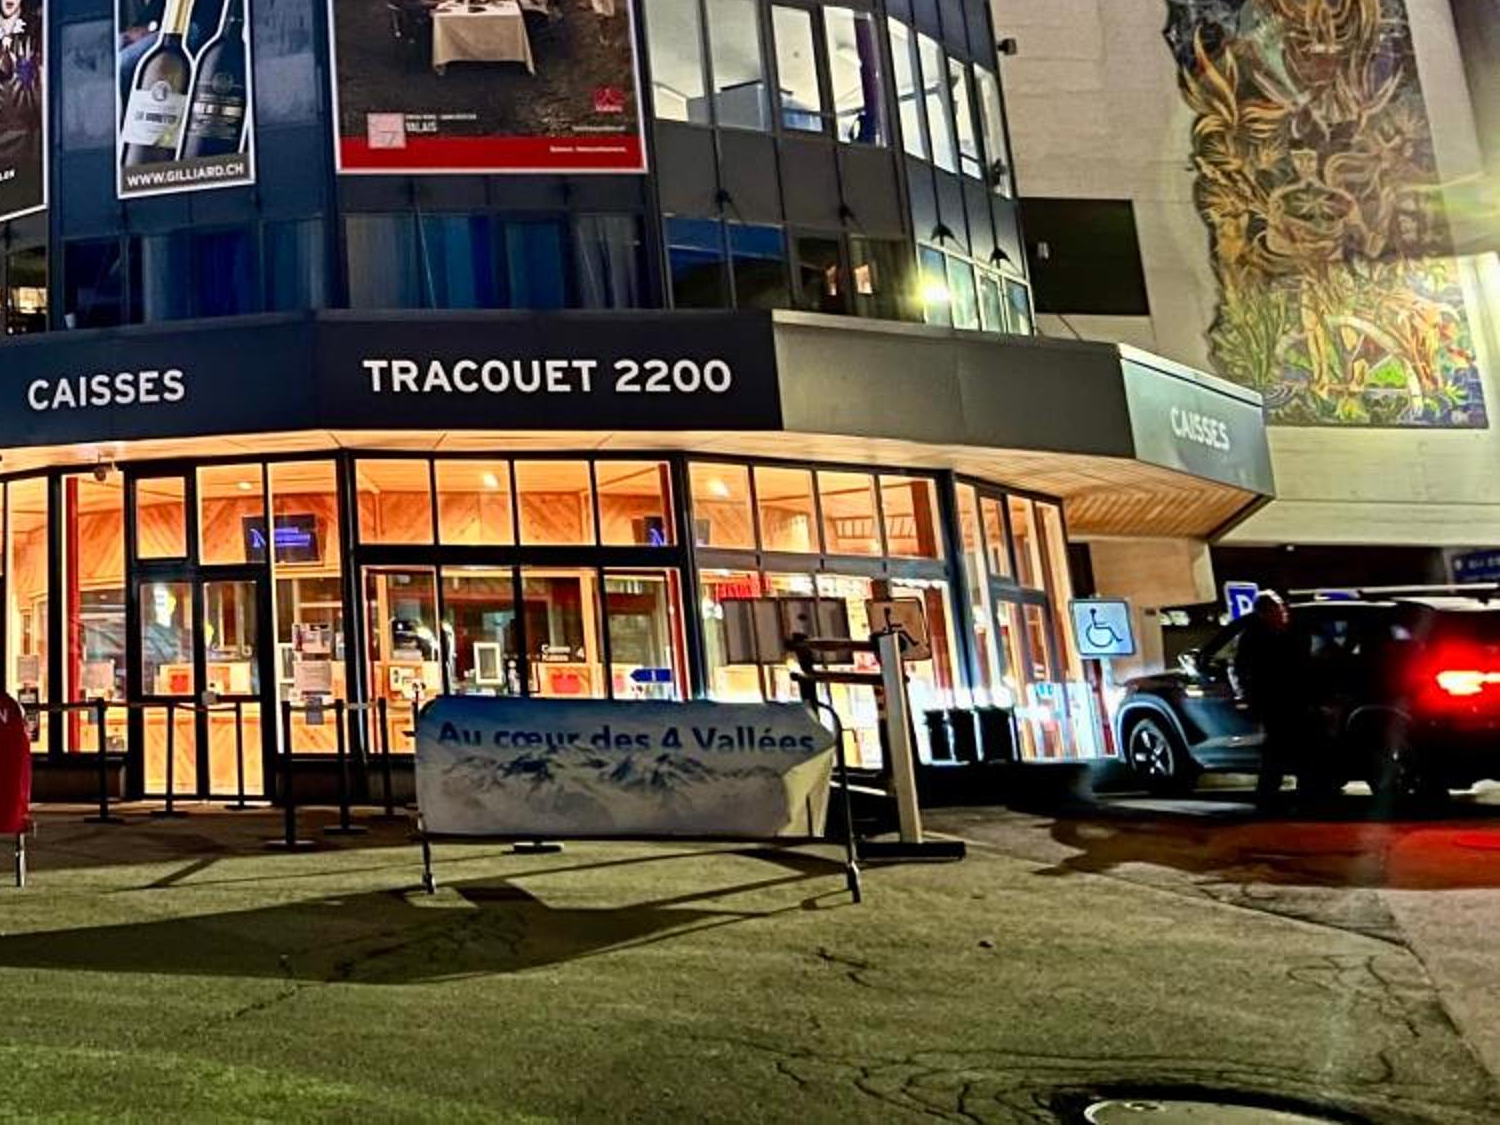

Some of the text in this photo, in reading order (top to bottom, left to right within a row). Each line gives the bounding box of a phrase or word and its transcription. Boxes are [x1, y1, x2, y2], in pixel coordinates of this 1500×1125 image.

[126, 162, 245, 187] WWW.GILLIARD.CH
[27, 369, 186, 412] CAISSES
[362, 359, 732, 393] TRACOUET 2200
[1169, 406, 1231, 452] CAISSES
[437, 722, 482, 746] Au
[590, 725, 650, 750] des
[660, 727, 682, 750] 4
[690, 726, 815, 752] Vallées
